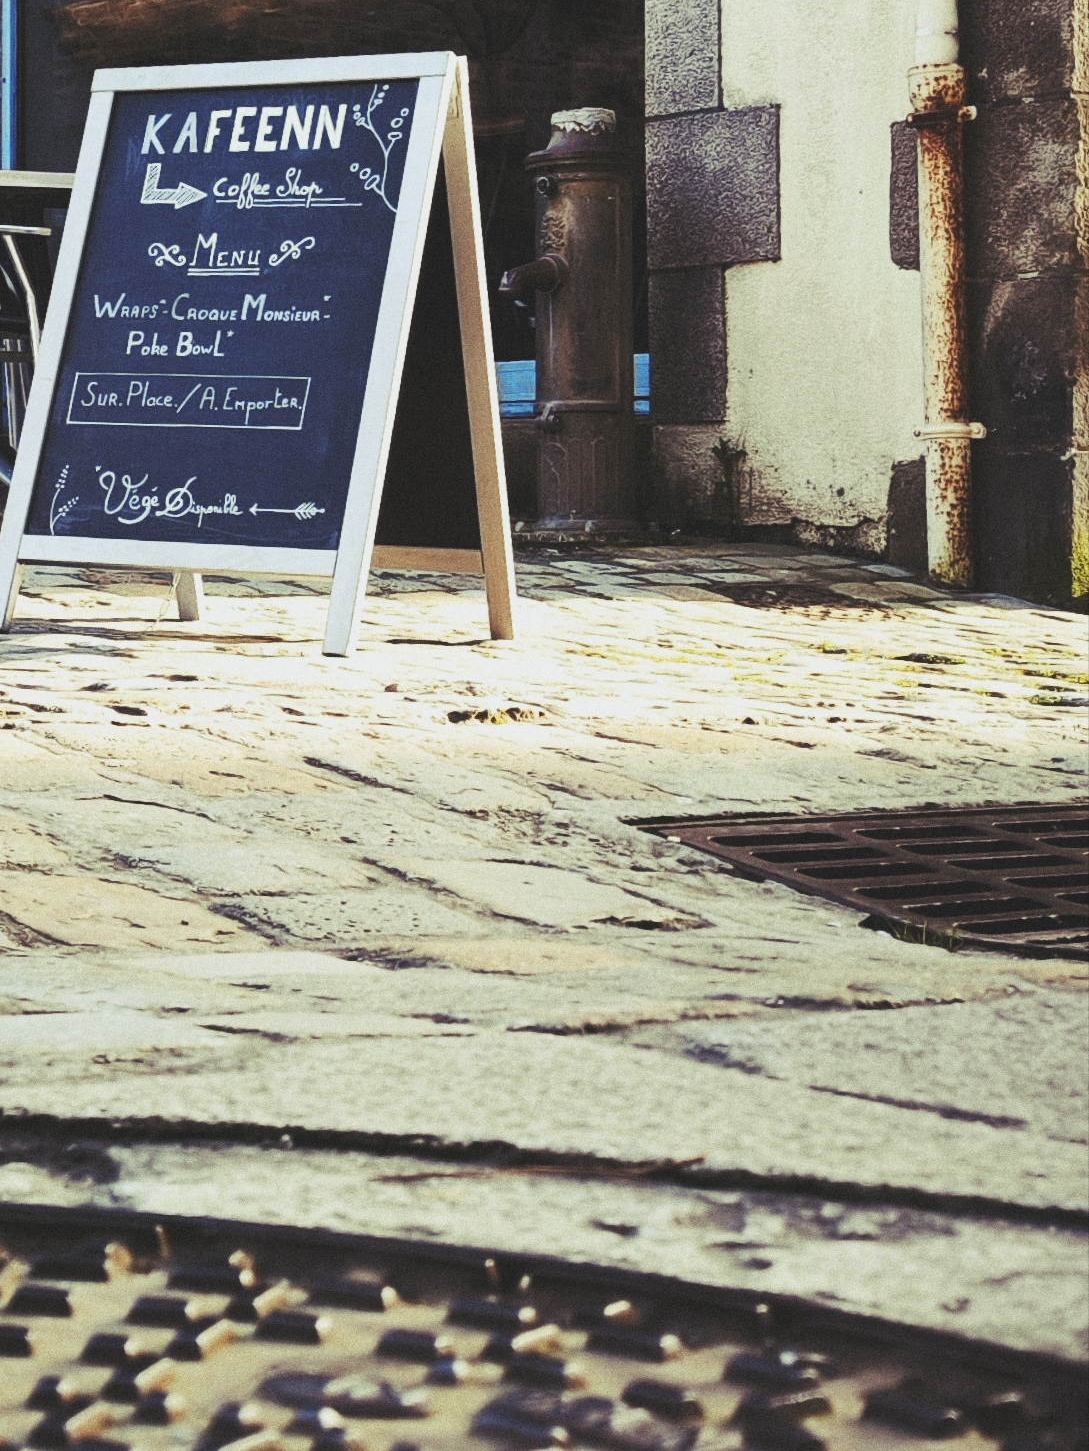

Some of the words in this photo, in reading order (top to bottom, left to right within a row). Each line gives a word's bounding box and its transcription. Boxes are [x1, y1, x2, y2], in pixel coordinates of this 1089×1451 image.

[140, 103, 348, 155] KAFEENN
[212, 172, 270, 209] Coffee
[276, 167, 323, 208] Shop
[155, 476, 243, 528] Disponible
